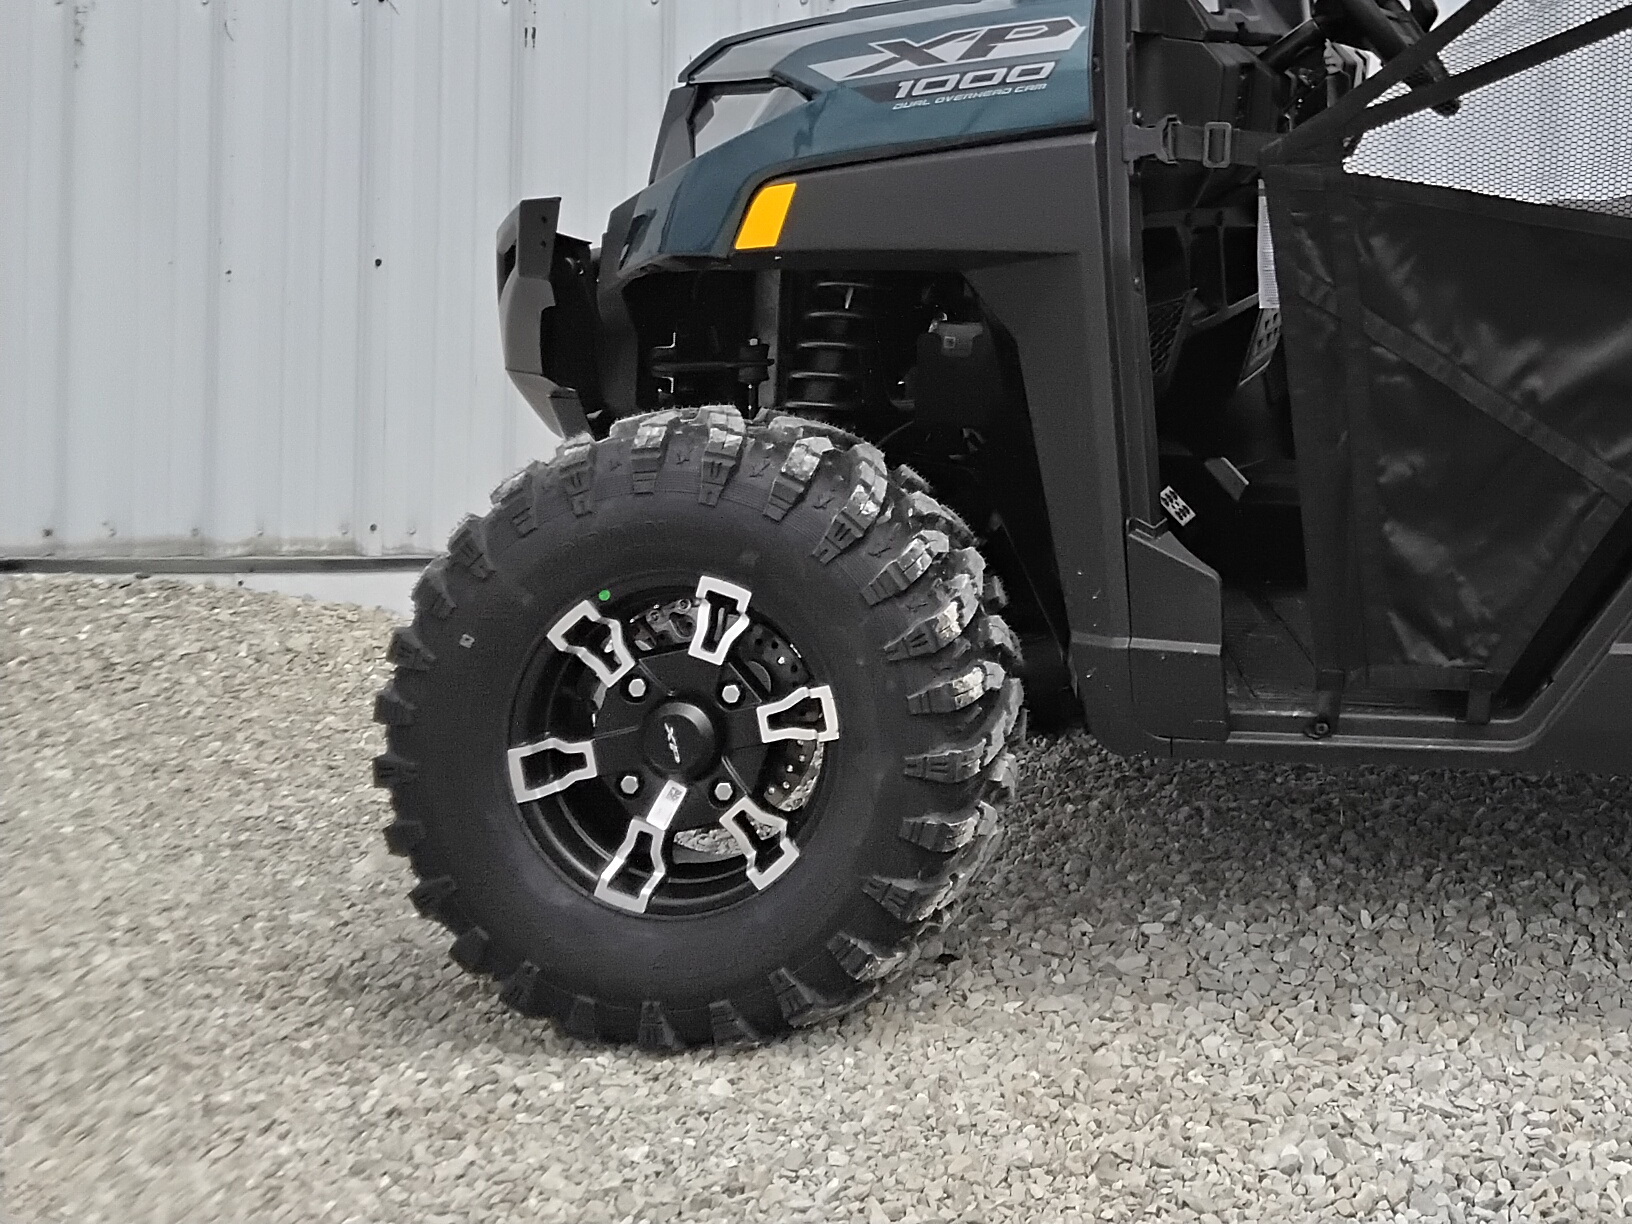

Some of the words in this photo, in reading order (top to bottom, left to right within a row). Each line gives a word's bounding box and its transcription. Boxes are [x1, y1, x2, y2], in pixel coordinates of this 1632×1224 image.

[842, 17, 1084, 80] XP
[892, 98, 931, 110] DUAL
[934, 87, 1012, 104] OVERHEAD
[1014, 83, 1048, 94] CAM
[895, 61, 1056, 99] 1000
